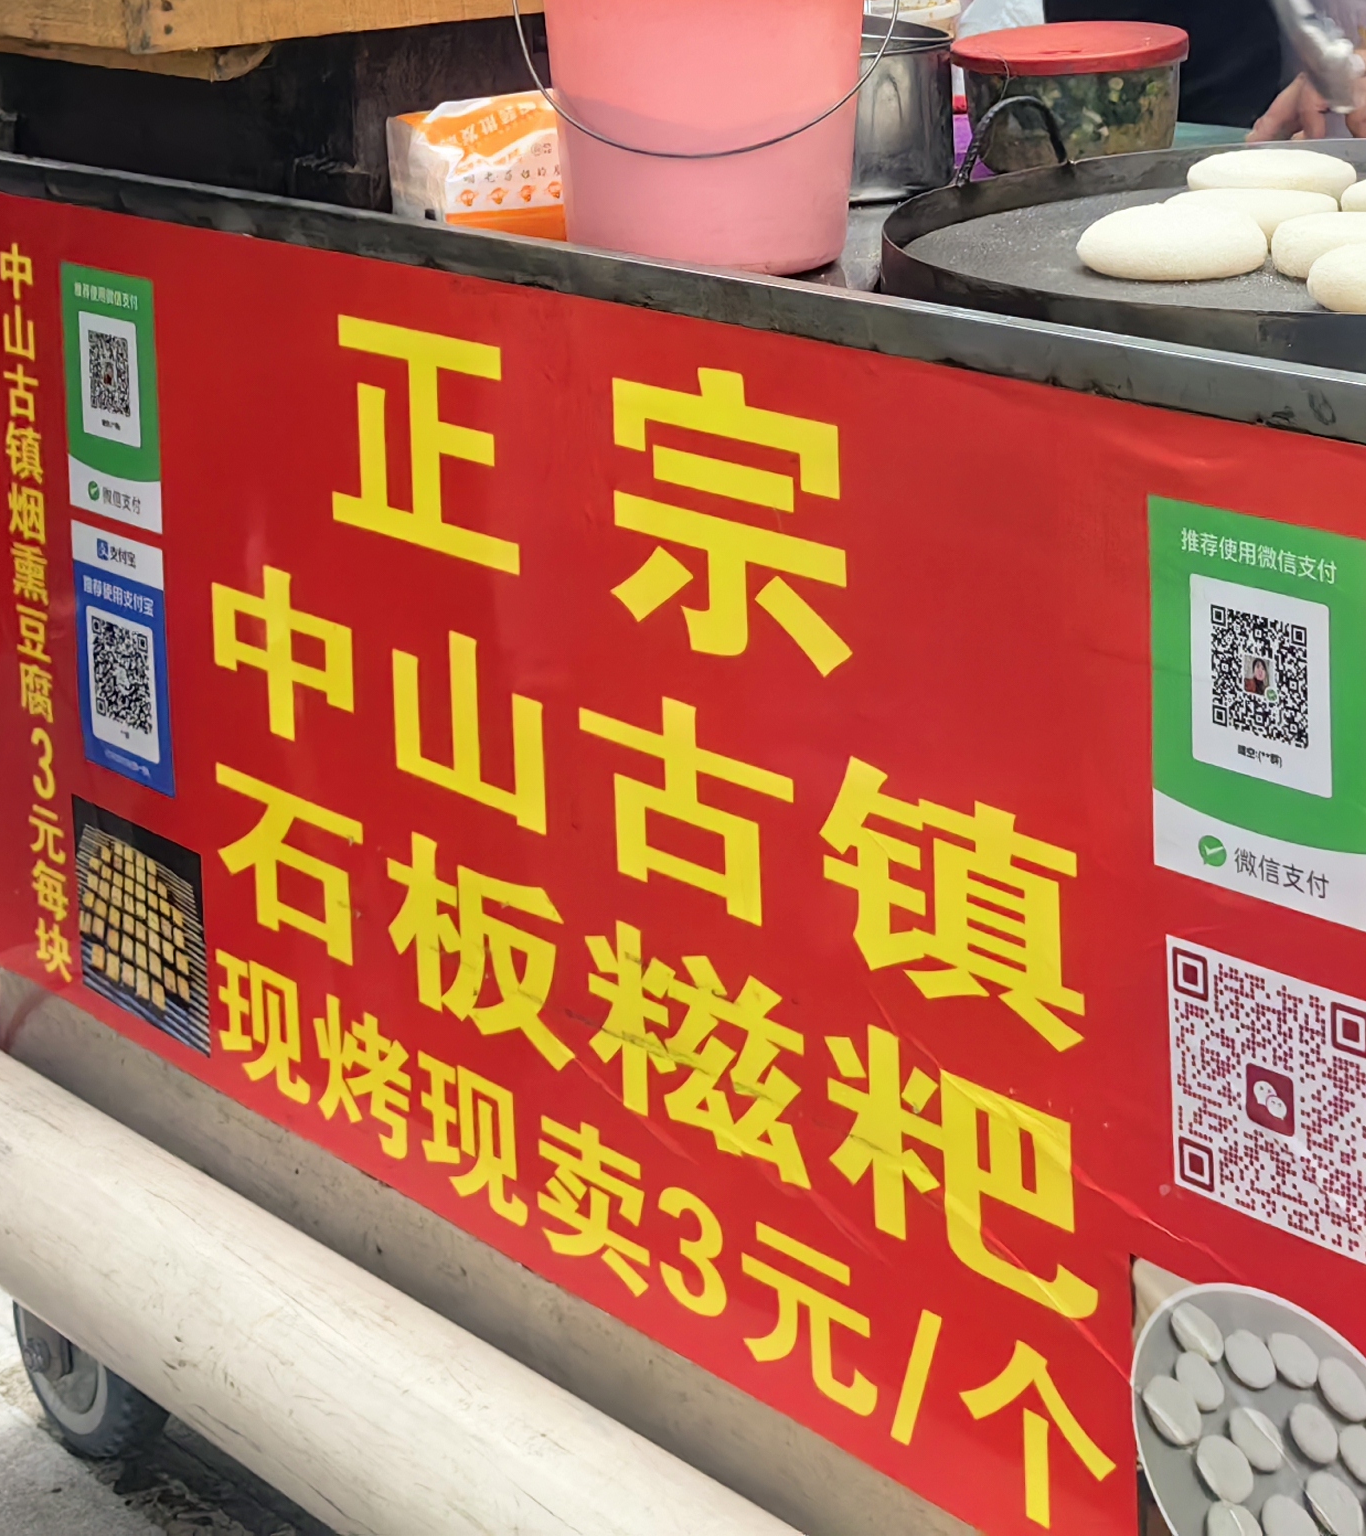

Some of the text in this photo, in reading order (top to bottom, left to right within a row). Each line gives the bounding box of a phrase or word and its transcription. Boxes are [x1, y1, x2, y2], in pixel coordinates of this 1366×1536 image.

[332, 314, 853, 677] 正宗
[1180, 526, 1338, 586] 推荐使用微信支付
[210, 566, 1087, 1054] 中山古镇
[1233, 847, 1330, 900] 微信支付
[215, 761, 1099, 1321] 石板糍粑
[217, 948, 1117, 1530] 现烤现卖3元/个
